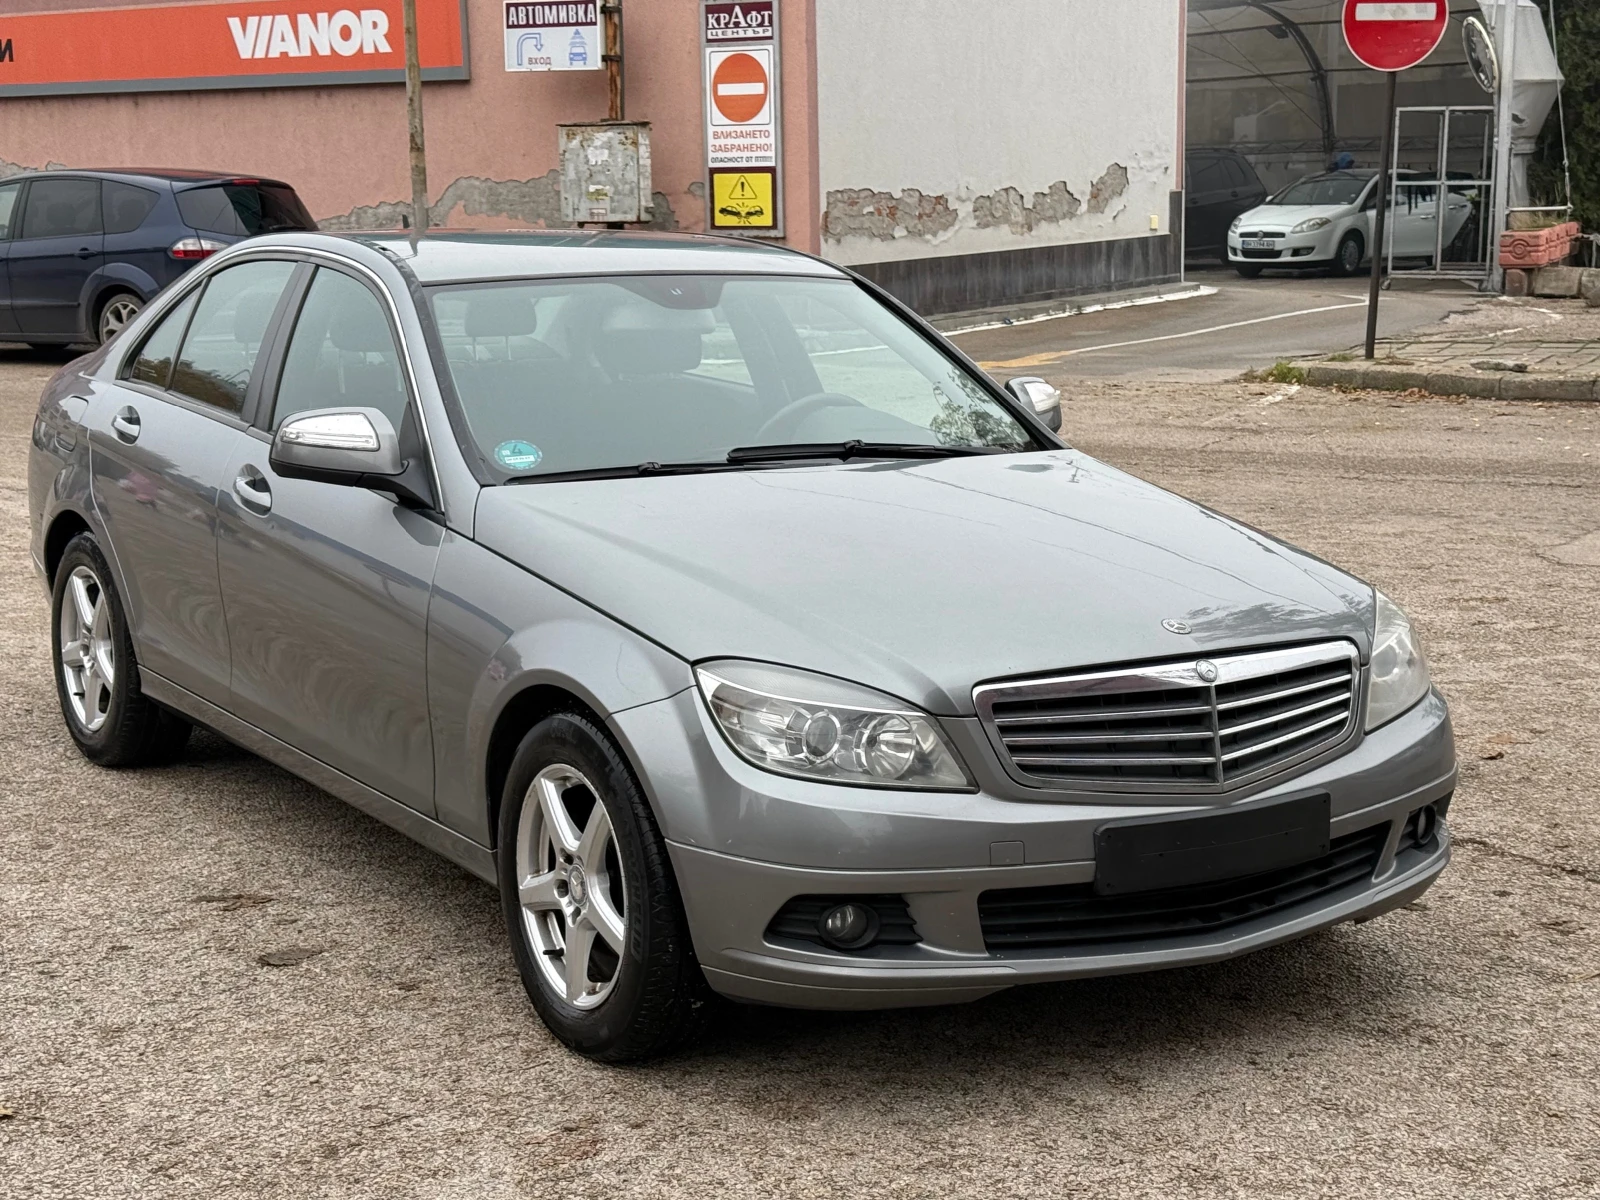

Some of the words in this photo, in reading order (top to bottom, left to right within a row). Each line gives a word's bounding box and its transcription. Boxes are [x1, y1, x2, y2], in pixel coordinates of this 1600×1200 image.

[508, 4, 595, 25] АВТОМИВКА
[227, 10, 393, 60] VIANOR
[710, 28, 770, 37] ЦЕНТЪР
[528, 57, 552, 65] ВХОД
[712, 129, 771, 140] ВЛИЗАНЕТО
[711, 143, 773, 153] ЗАБРАНЕНО!
[512, 444, 523, 455] 4
